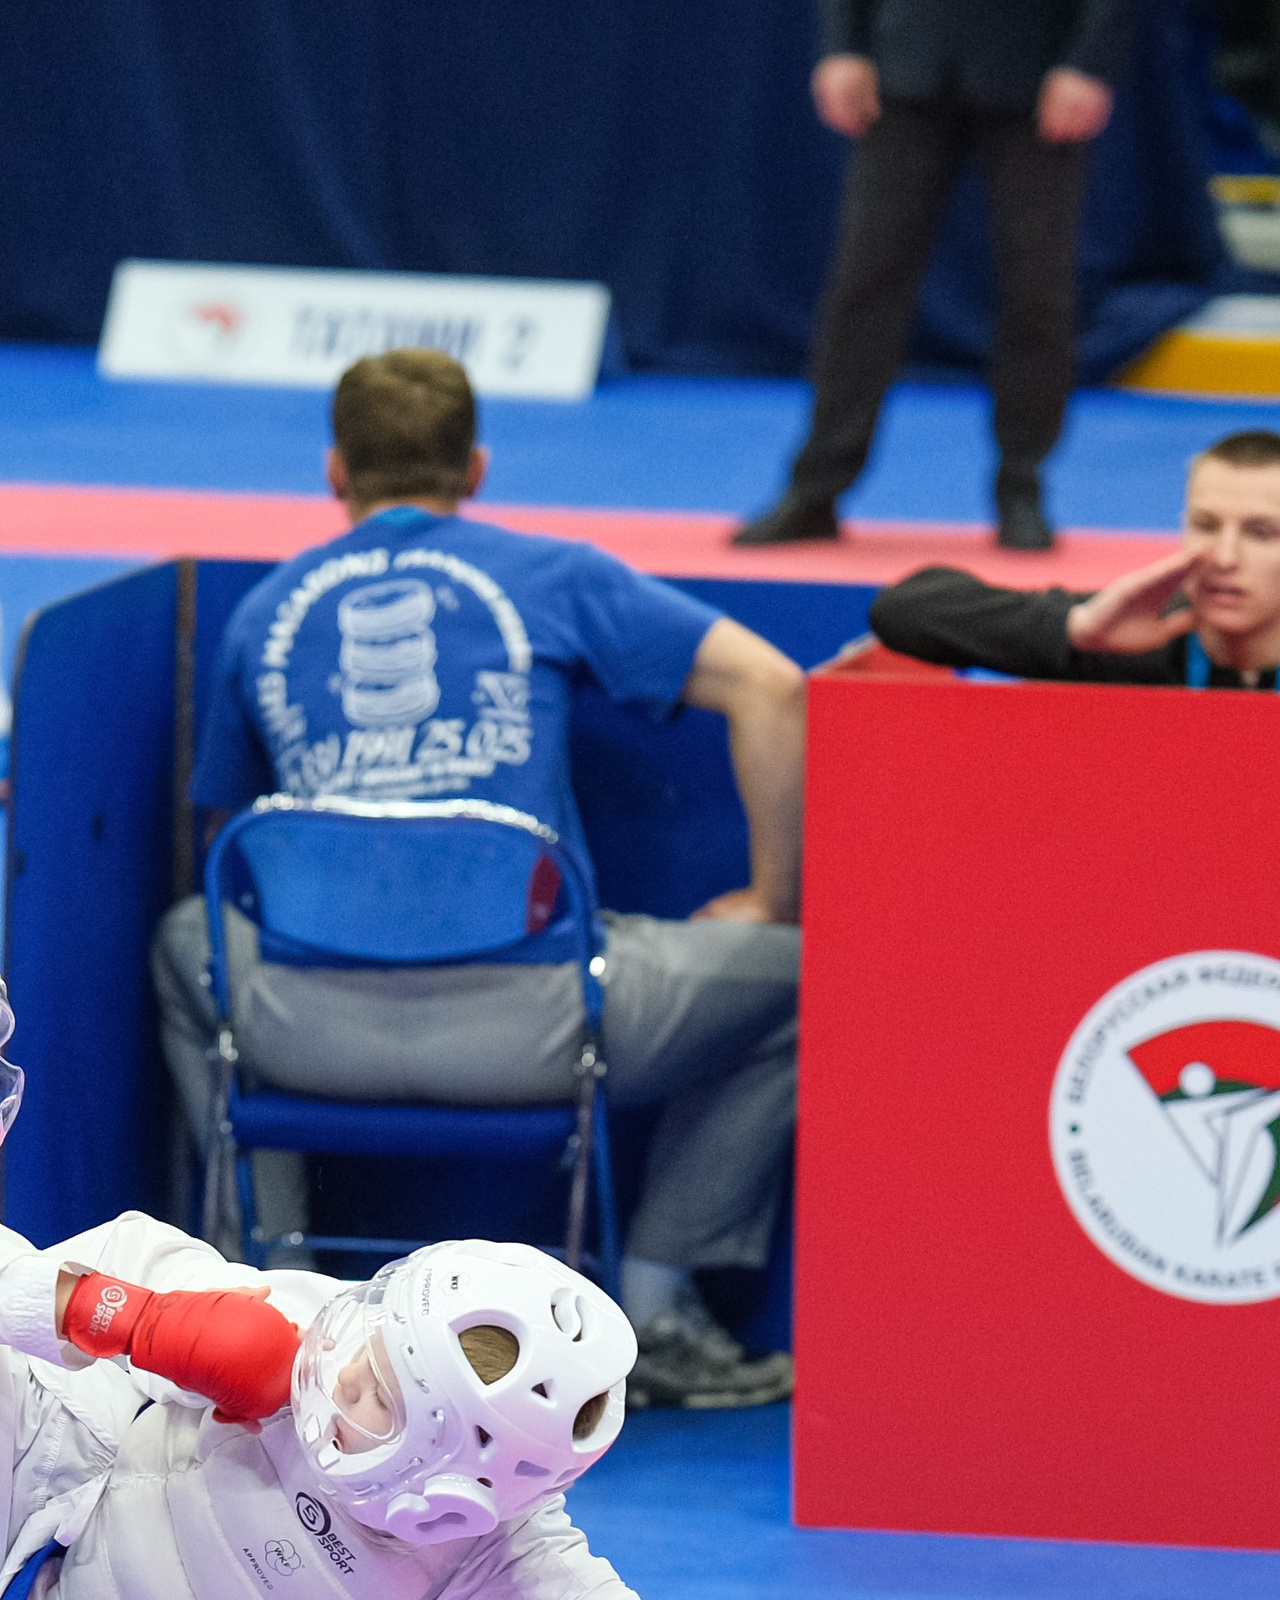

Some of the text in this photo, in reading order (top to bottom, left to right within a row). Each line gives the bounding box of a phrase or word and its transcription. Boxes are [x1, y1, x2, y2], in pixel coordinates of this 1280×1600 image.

[88, 1302, 107, 1336] SPORT
[99, 1305, 117, 1334] BEST
[274, 1547, 291, 1568] WKF
[317, 1536, 355, 1574] SPORT
[326, 1532, 357, 1561] BEST
[242, 1548, 274, 1590] APPROVED
